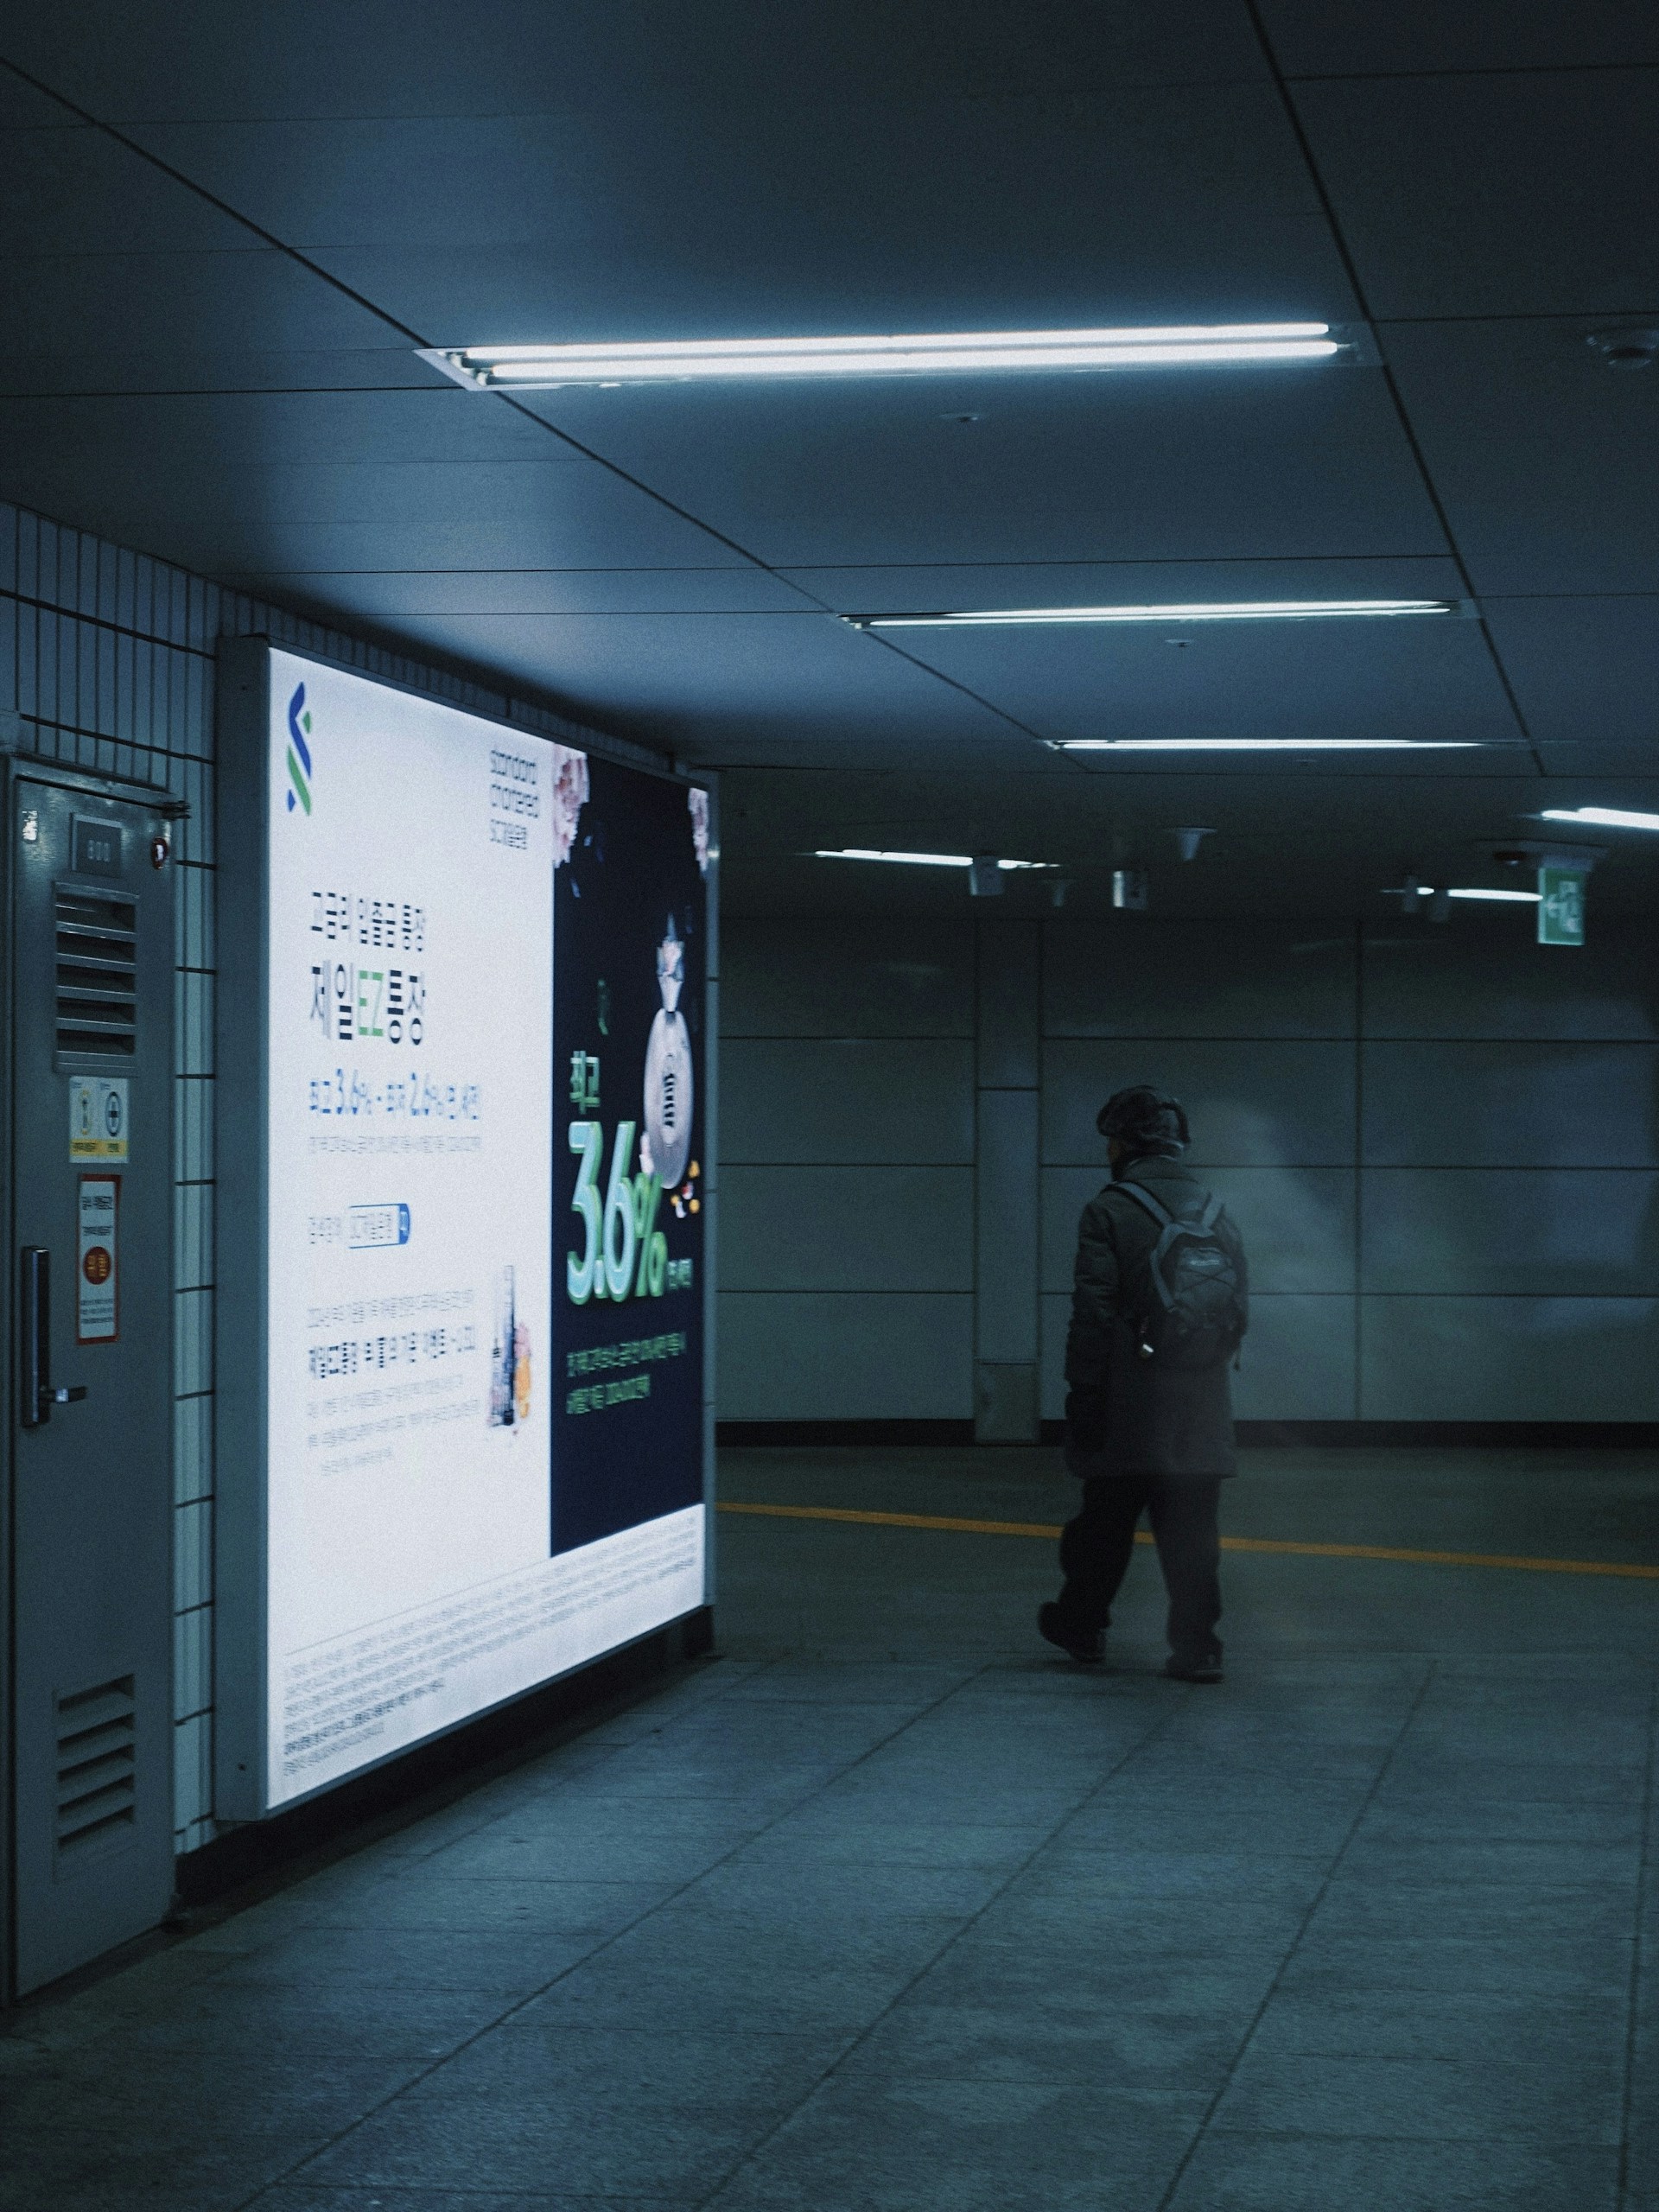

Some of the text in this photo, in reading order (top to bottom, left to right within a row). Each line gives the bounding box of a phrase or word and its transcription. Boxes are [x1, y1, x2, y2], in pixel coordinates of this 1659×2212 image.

[490, 748, 537, 785] standard
[490, 783, 539, 818] chartered
[310, 891, 427, 952] 고금리 입출금 통장
[309, 960, 427, 1046] 제일EZ통장
[335, 1068, 372, 1116] 3.6%
[410, 1071, 442, 1116] 2.6%
[569, 1050, 601, 1115] 최고
[567, 1121, 668, 1305] 3.6%
